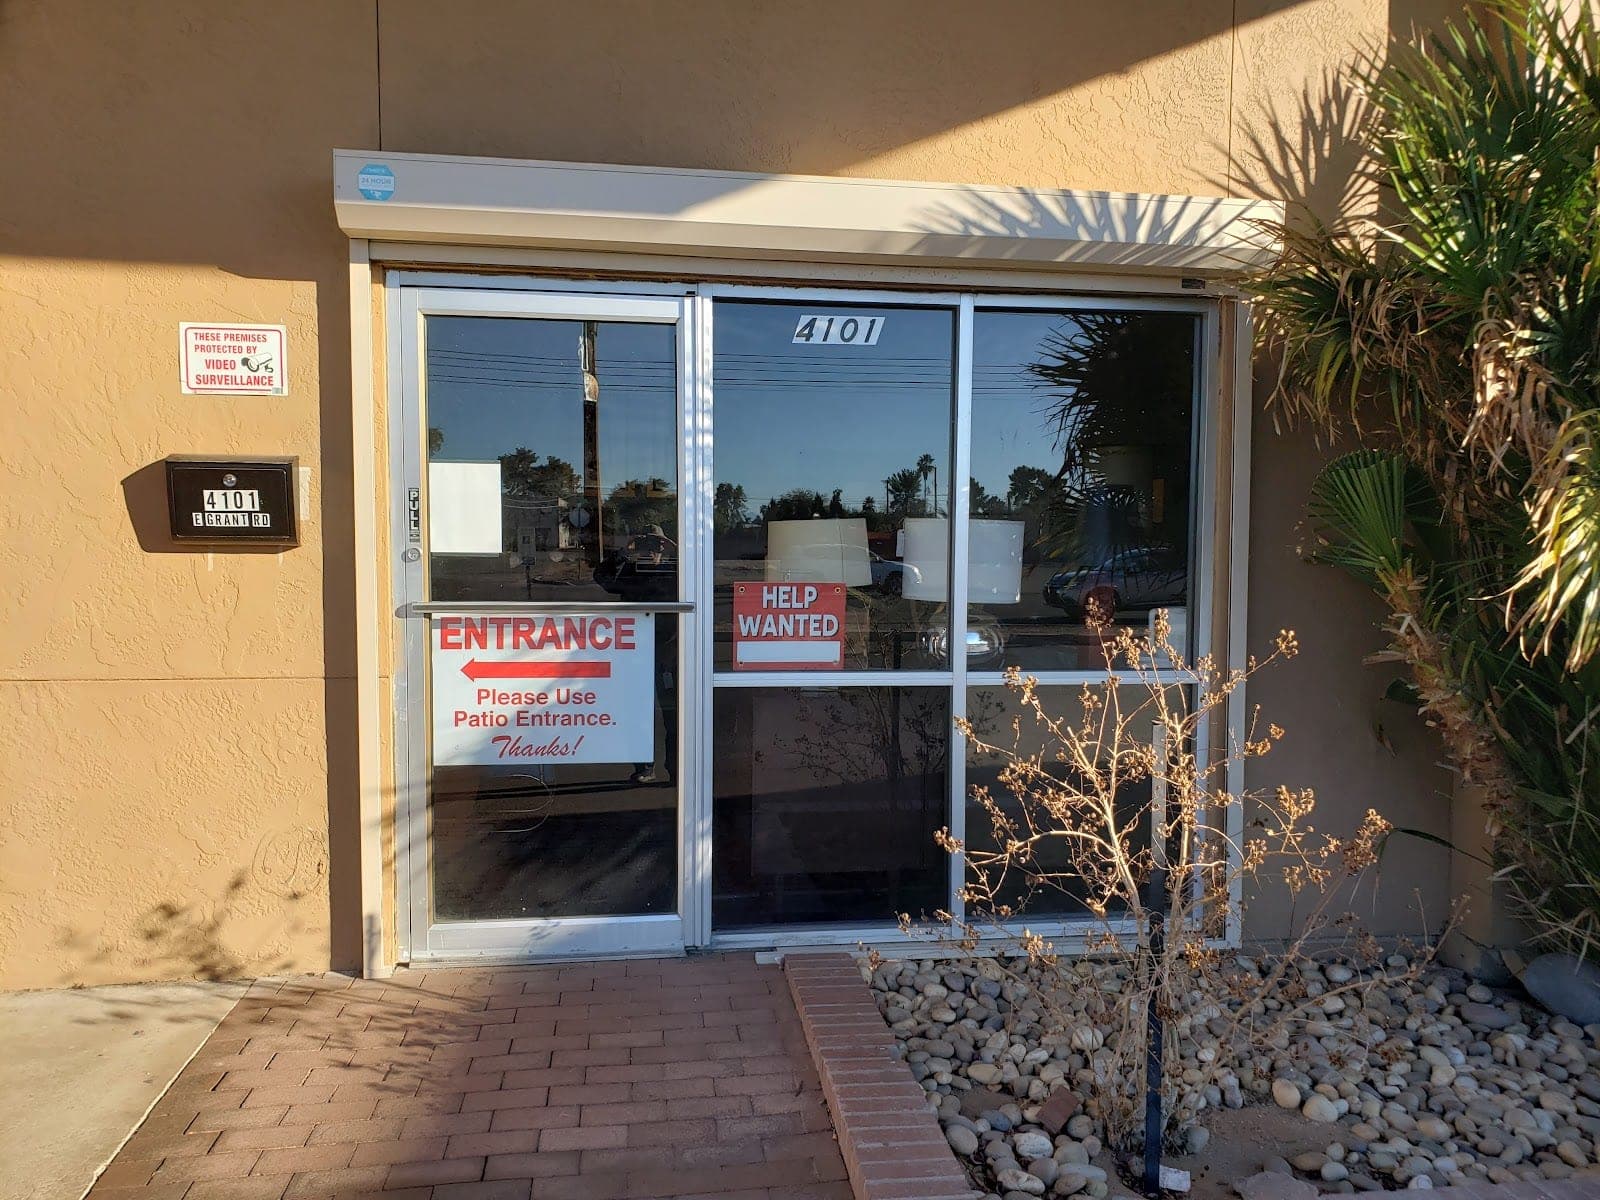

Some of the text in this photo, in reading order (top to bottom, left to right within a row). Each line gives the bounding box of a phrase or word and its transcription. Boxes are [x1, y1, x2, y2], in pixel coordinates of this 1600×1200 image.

[194, 332, 267, 343] THESE PREMISES
[795, 317, 877, 343] 4101
[194, 344, 257, 354] PROTECTED BY
[204, 358, 237, 370] VIDEO
[195, 374, 274, 386] SURVEILLANCE
[206, 491, 256, 510] 4101
[194, 513, 269, 526] E GRANT RD
[409, 491, 419, 530] PULL
[762, 586, 818, 609] HELP
[440, 617, 636, 650] ENTRANCE
[738, 614, 839, 637] WANTED
[477, 688, 597, 705] Please Use
[454, 710, 617, 727] Patio Entrance.
[491, 735, 585, 759] Thanks!
